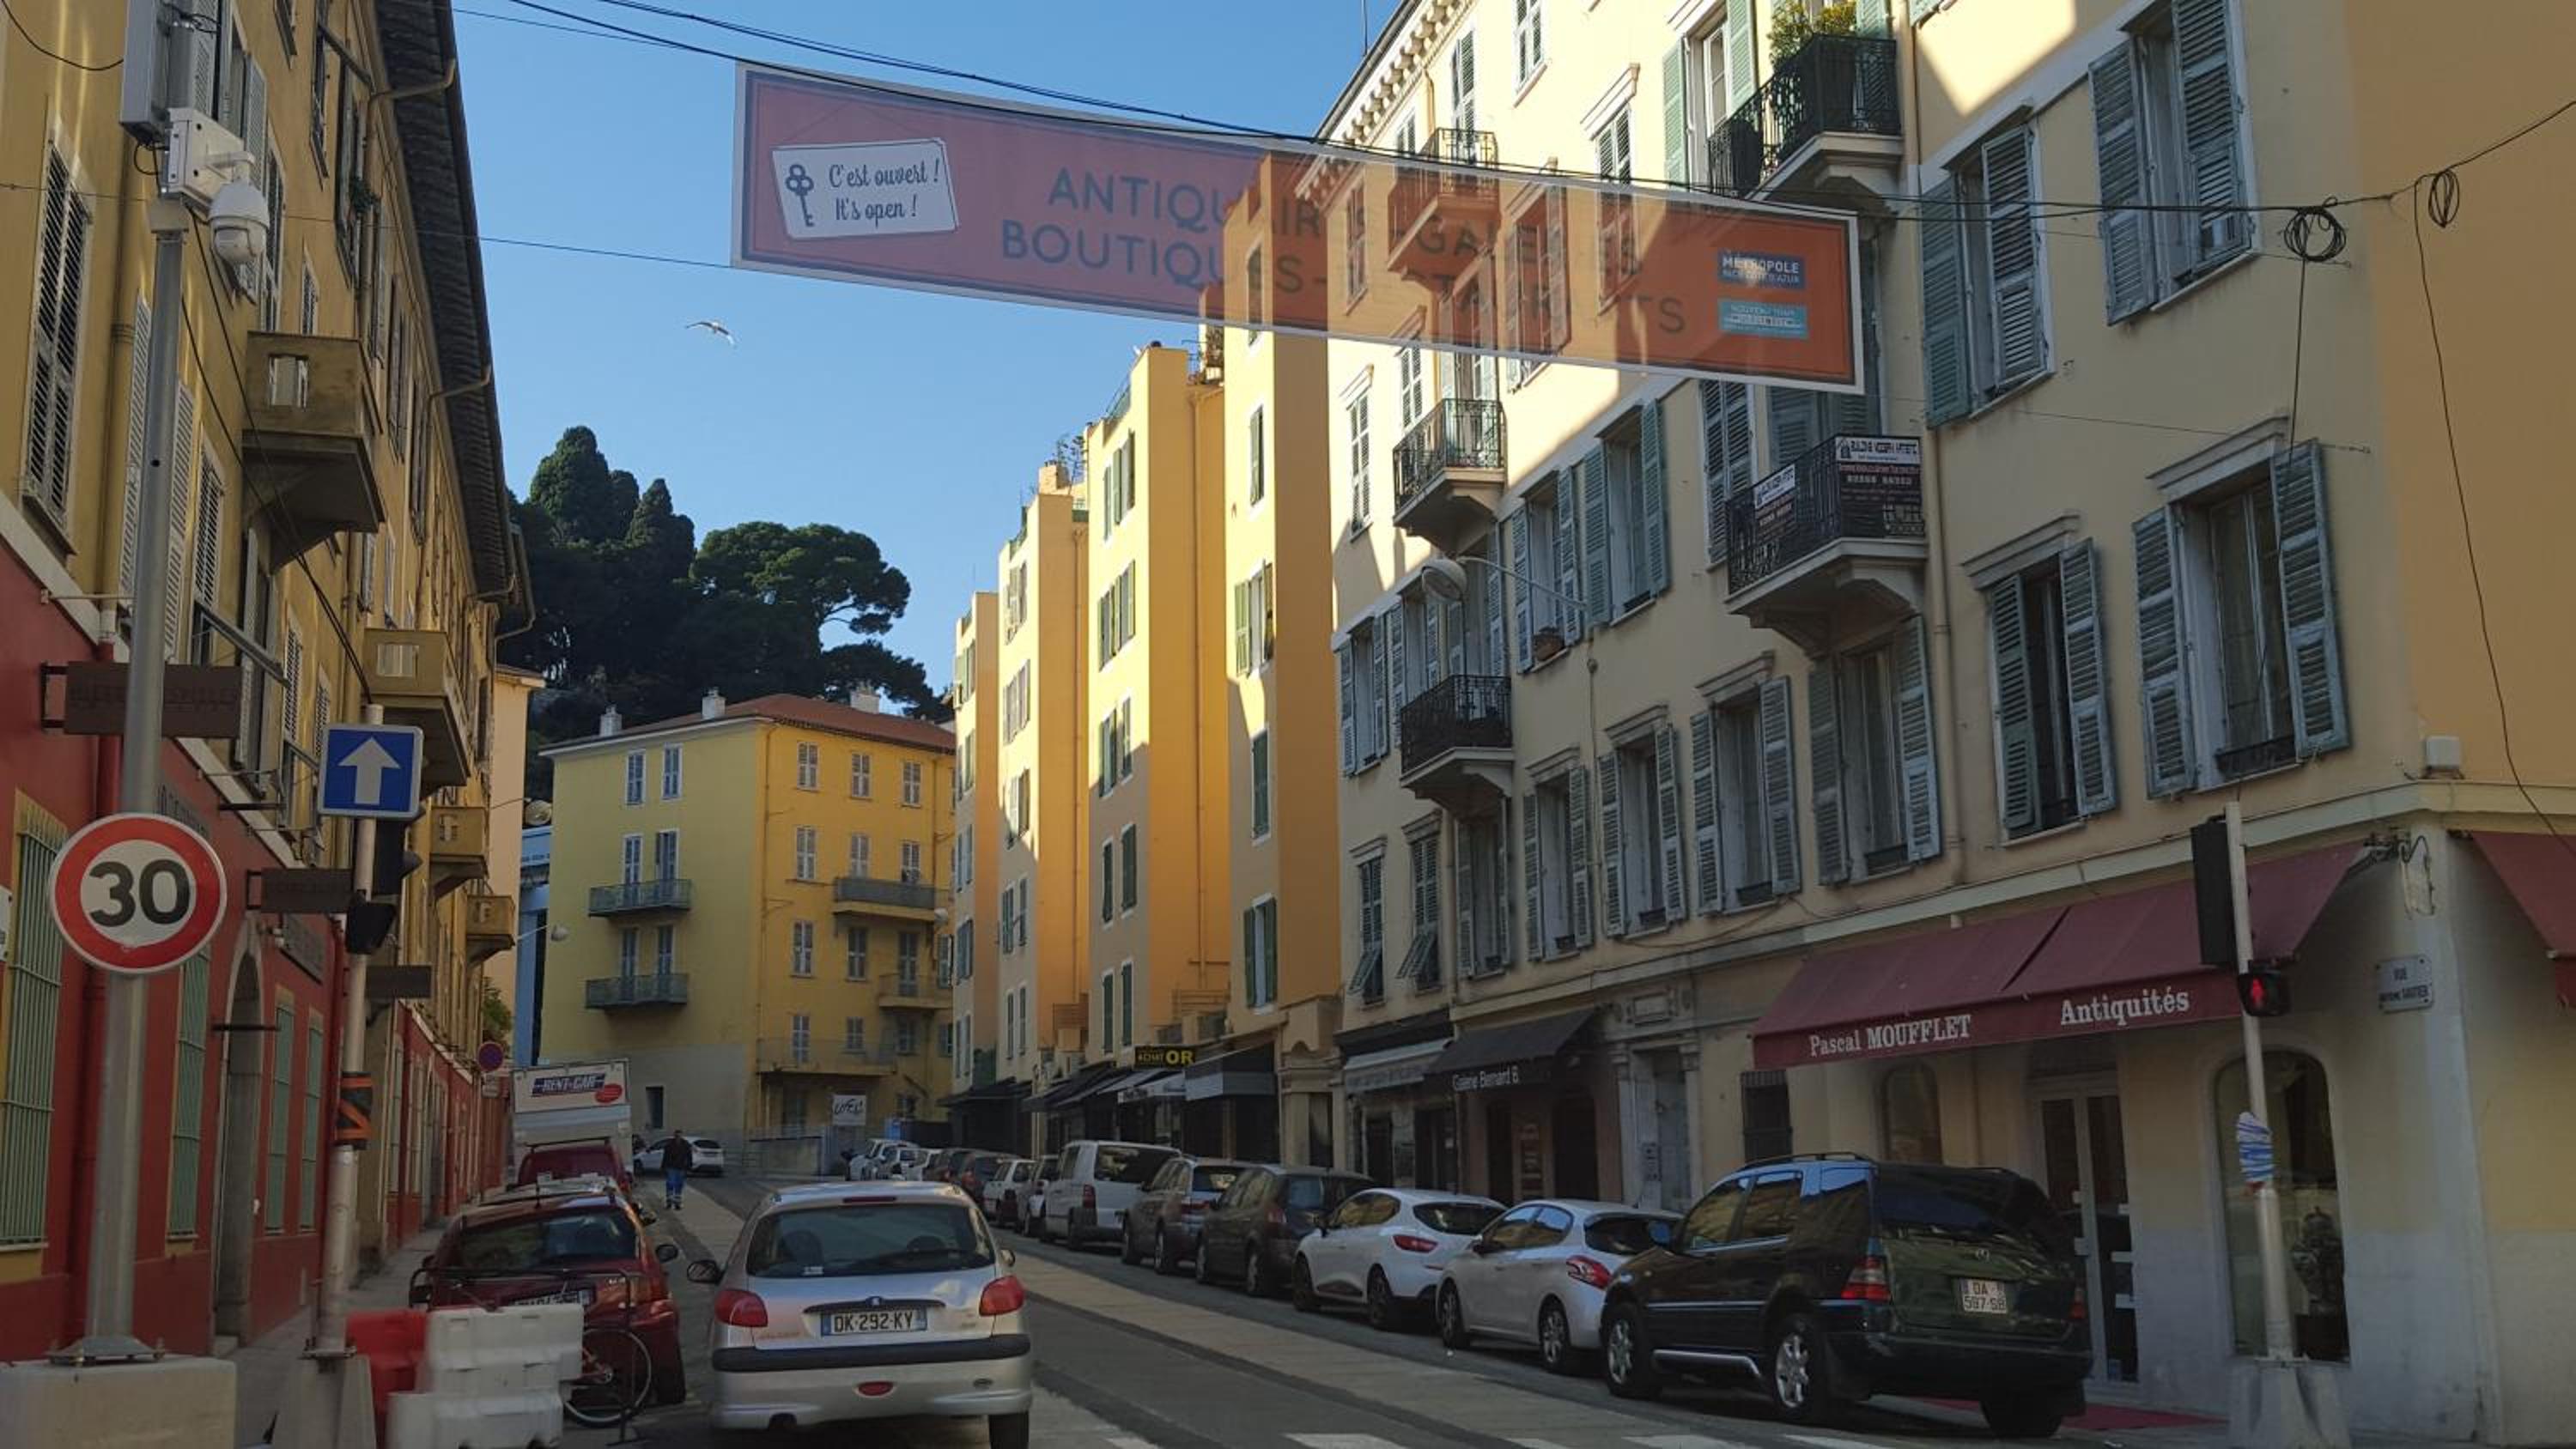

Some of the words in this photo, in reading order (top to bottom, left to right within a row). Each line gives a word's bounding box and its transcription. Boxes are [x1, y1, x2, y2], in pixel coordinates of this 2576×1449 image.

[829, 164, 871, 188] C'est
[875, 160, 928, 186] ouvert
[835, 197, 861, 221] It's
[865, 202, 905, 228] open
[88, 859, 191, 928] 30
[2061, 986, 2190, 1027] Antiquités
[1809, 1033, 1861, 1057] Pascal
[1867, 1014, 1972, 1050] MOUFFLET
[1166, 1049, 1194, 1065] OR
[574, 1076, 597, 1089] CAR
